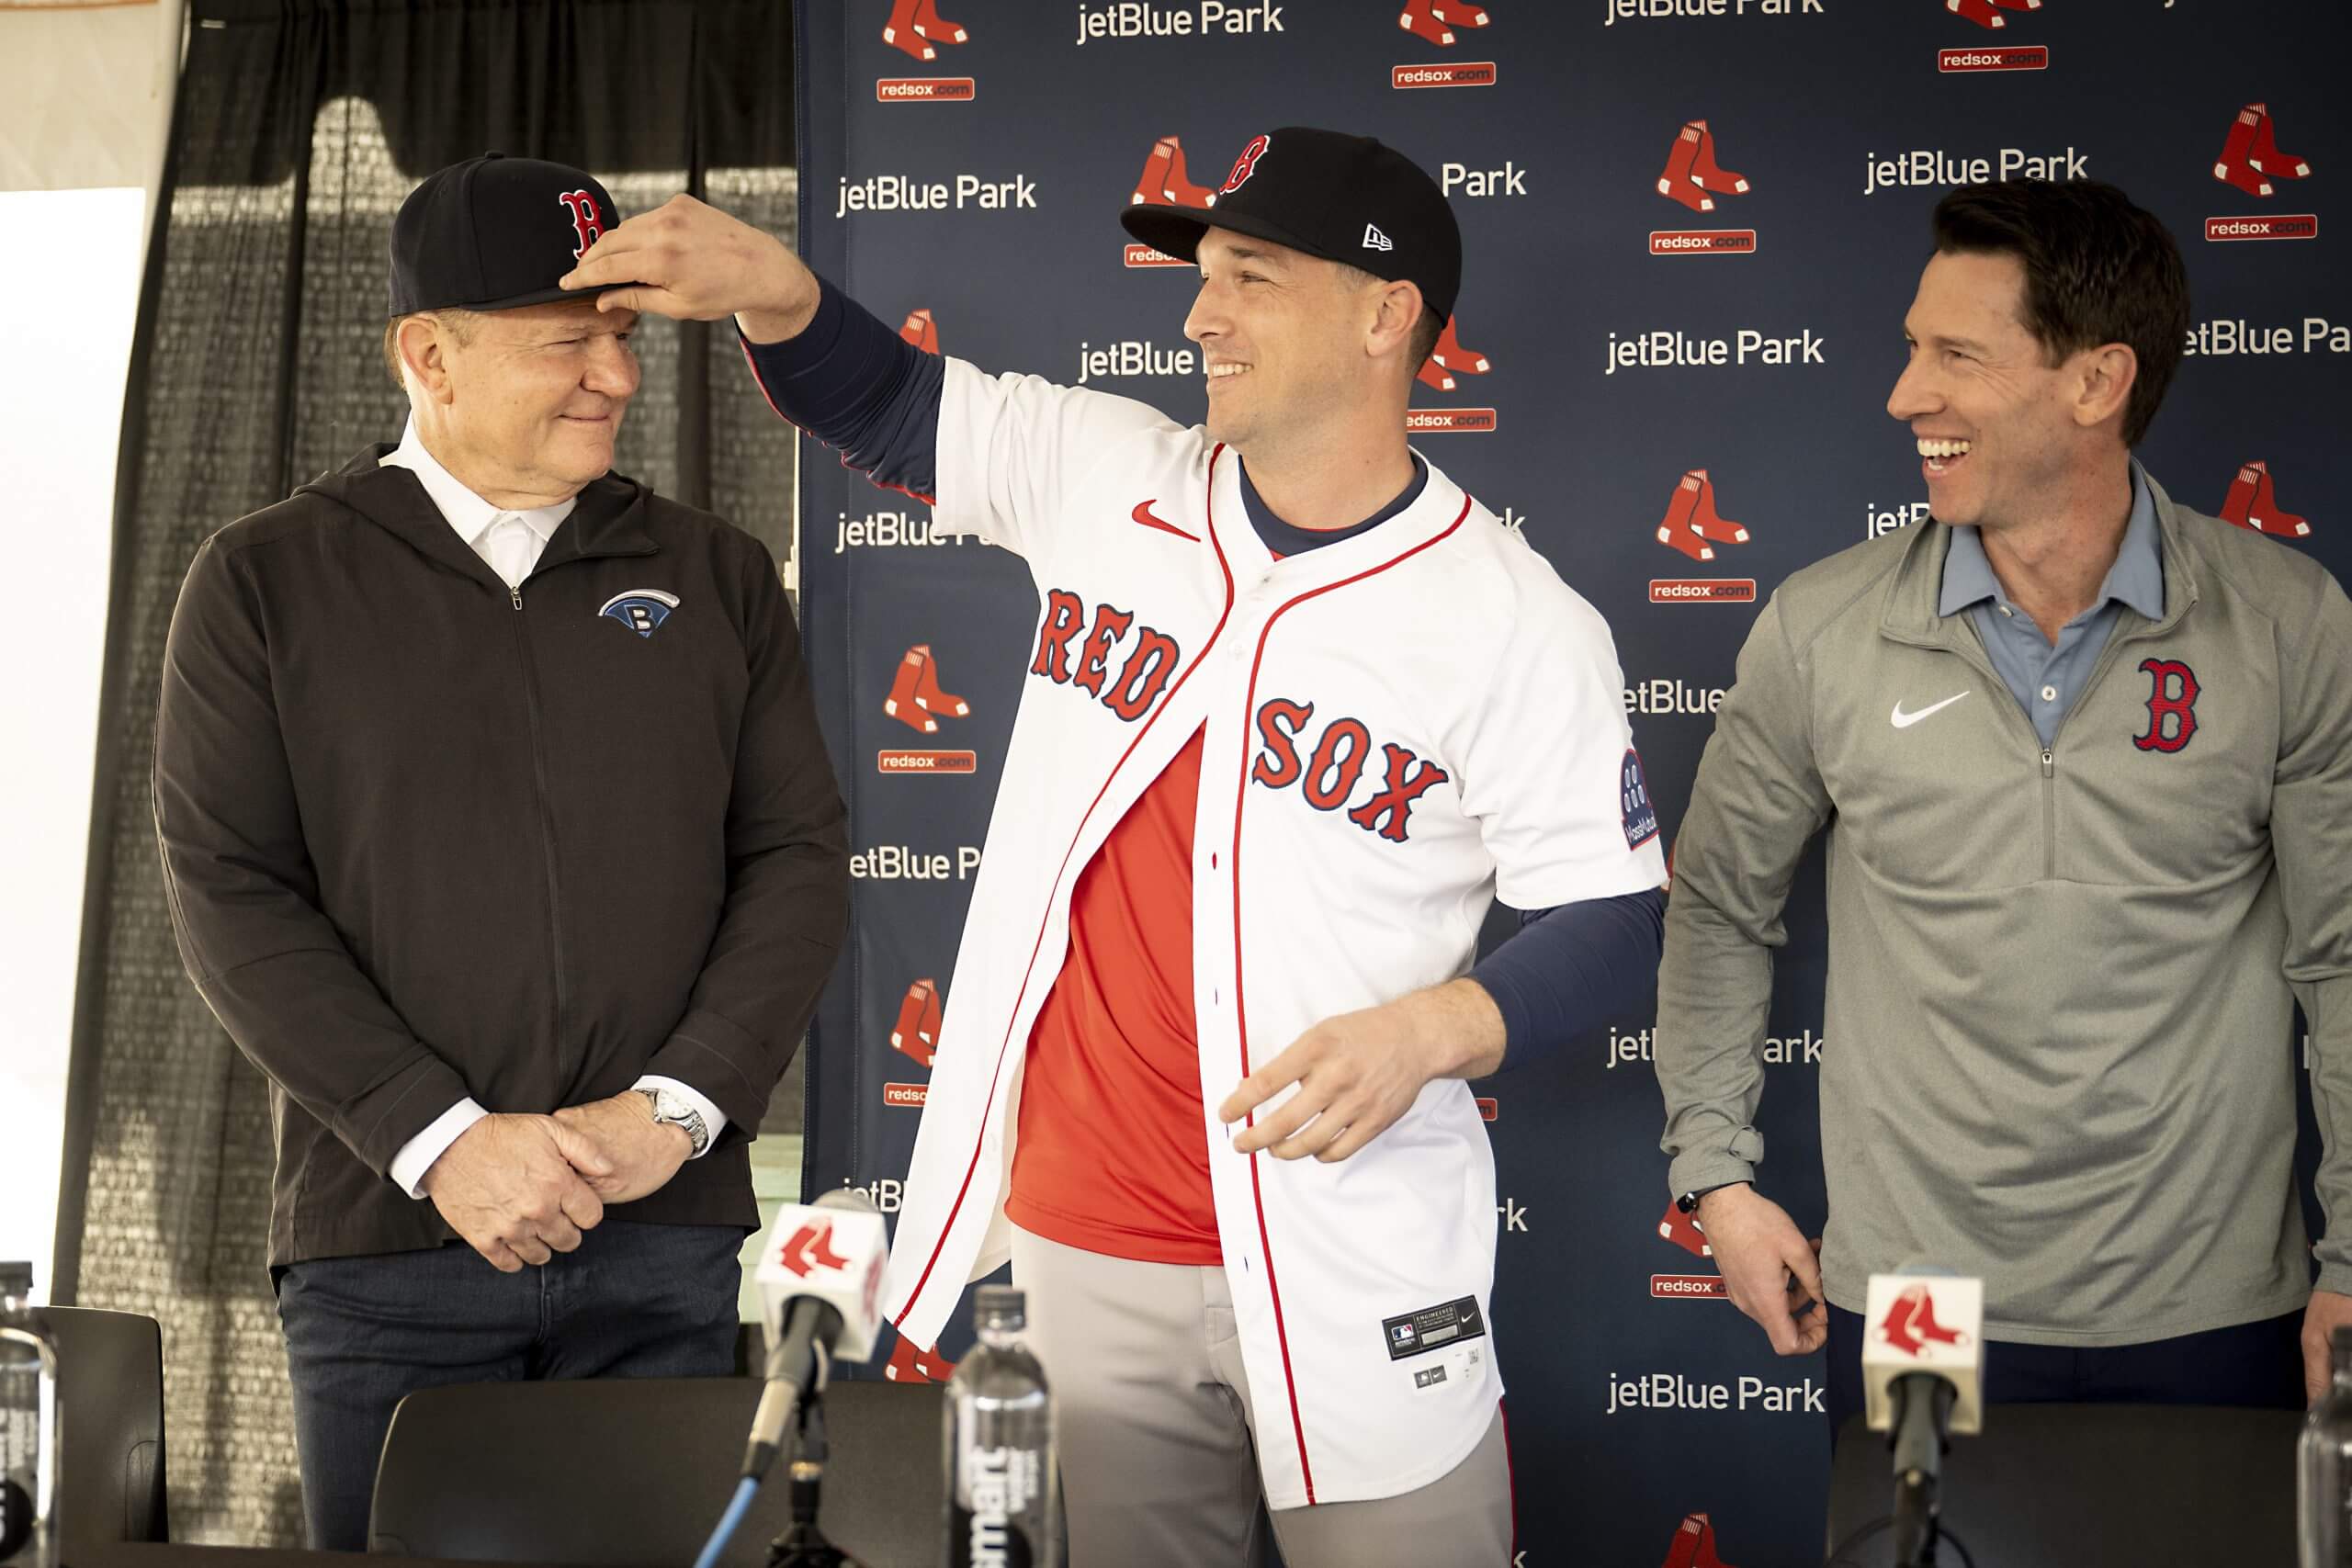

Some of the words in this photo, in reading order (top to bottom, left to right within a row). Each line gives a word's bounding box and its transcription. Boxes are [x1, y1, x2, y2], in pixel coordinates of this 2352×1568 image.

[1078, 3, 1192, 45] jetBlue
[1202, 0, 1283, 33] Park
[1397, 70, 1489, 83] redsox.com
[1944, 53, 2043, 66] redsox.com
[882, 83, 969, 96] redsox.com
[1219, 135, 1271, 195] B
[1442, 162, 1527, 197] Park
[1864, 151, 1990, 195] jetBlue
[2000, 147, 2088, 182] Park
[836, 175, 949, 219] jetBlue
[957, 175, 1037, 209] Park
[1655, 236, 1749, 249] redsox.com
[2211, 221, 2312, 235] redsox.com
[1606, 332, 1728, 375] jetBlue
[1737, 330, 1825, 365] Park
[2183, 320, 2293, 355] etBlue
[2303, 318, 2351, 353] Pa
[1079, 342, 1194, 383] jetBlue
[1407, 414, 1490, 427] edsox.com
[1655, 584, 1749, 596] redsox.com
[1623, 679, 1725, 714] etBlue
[2132, 658, 2201, 753] B
[1031, 589, 1180, 722] RED
[1252, 698, 1449, 843] SOX
[883, 755, 970, 767] redsox.com
[849, 846, 950, 879] etBlue
[1763, 1029, 1824, 1064] ark
[1607, 1372, 1729, 1414] jetBlue
[1739, 1377, 1826, 1413] Park
